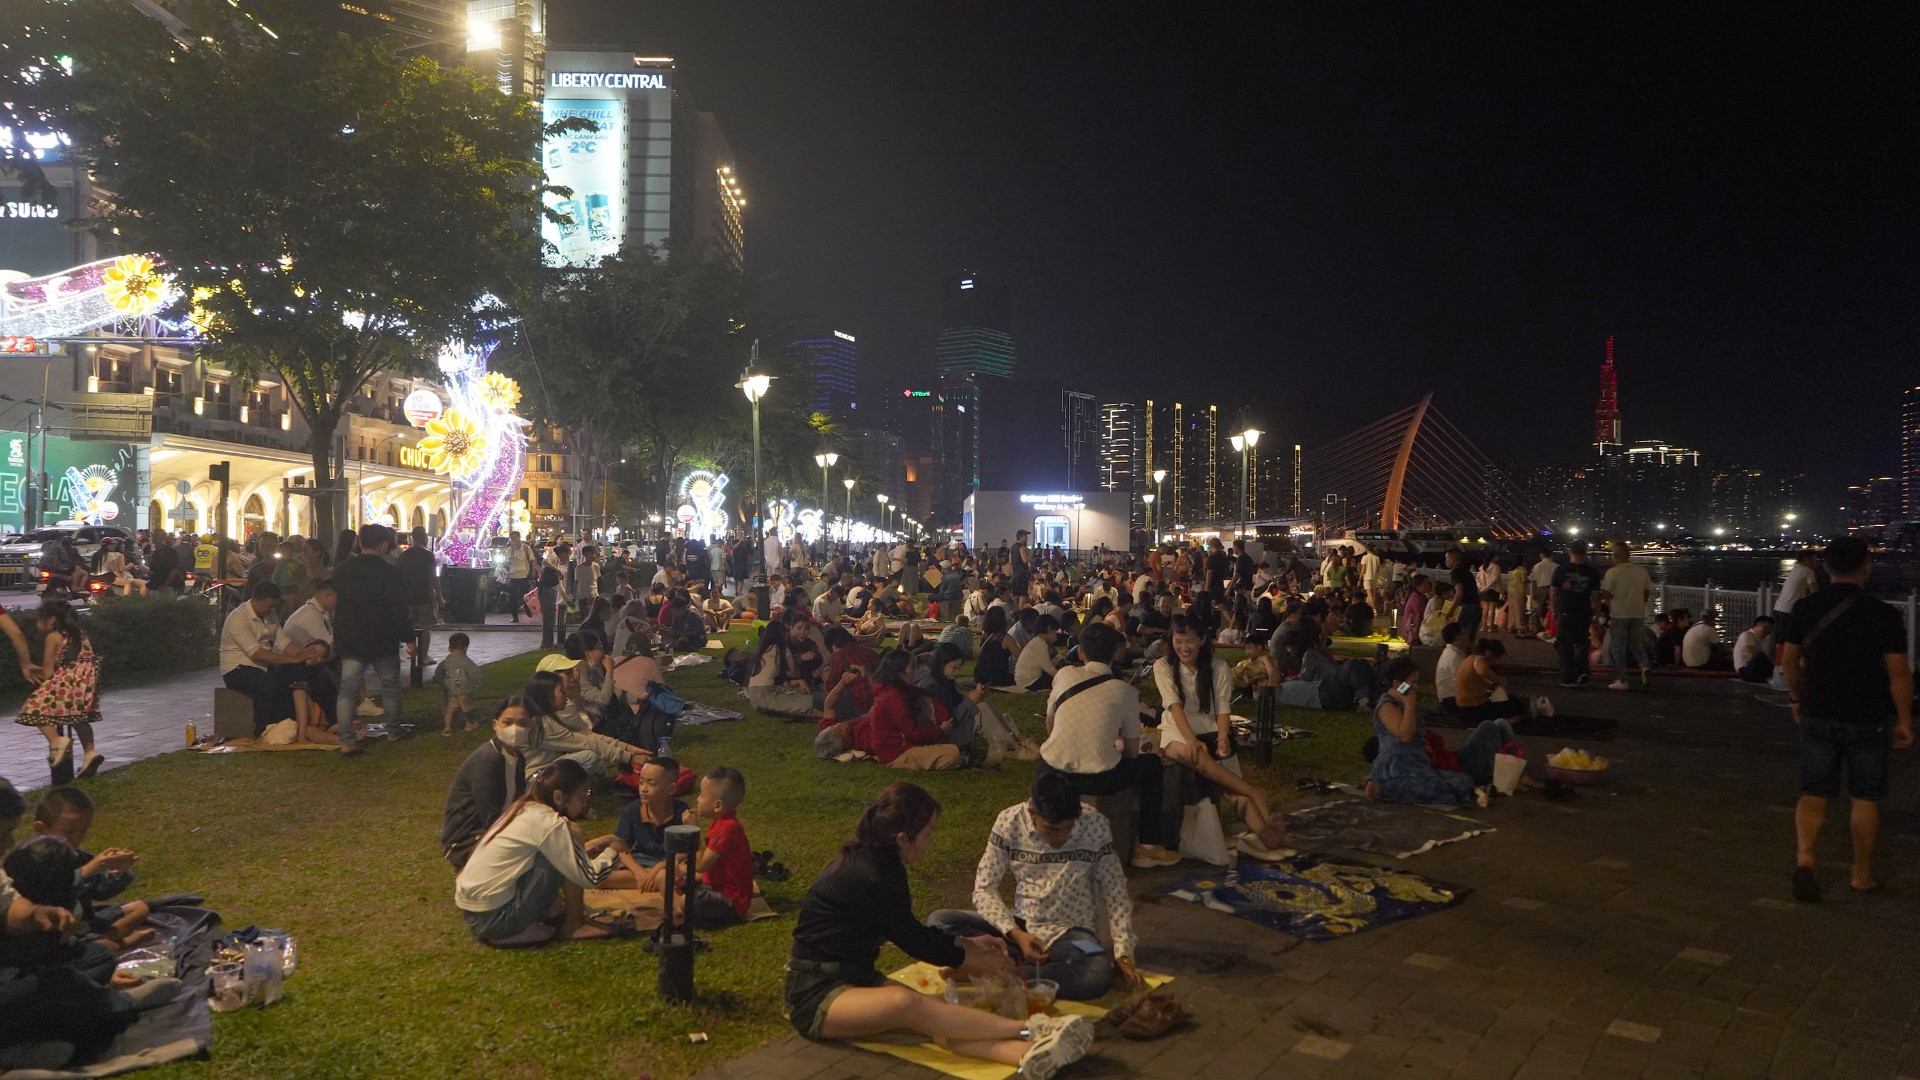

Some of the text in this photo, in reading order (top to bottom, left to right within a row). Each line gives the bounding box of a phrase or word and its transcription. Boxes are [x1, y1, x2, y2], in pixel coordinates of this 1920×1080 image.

[552, 72, 667, 89] LIBERTY CENTRAL
[0, 201, 59, 218] SUNG
